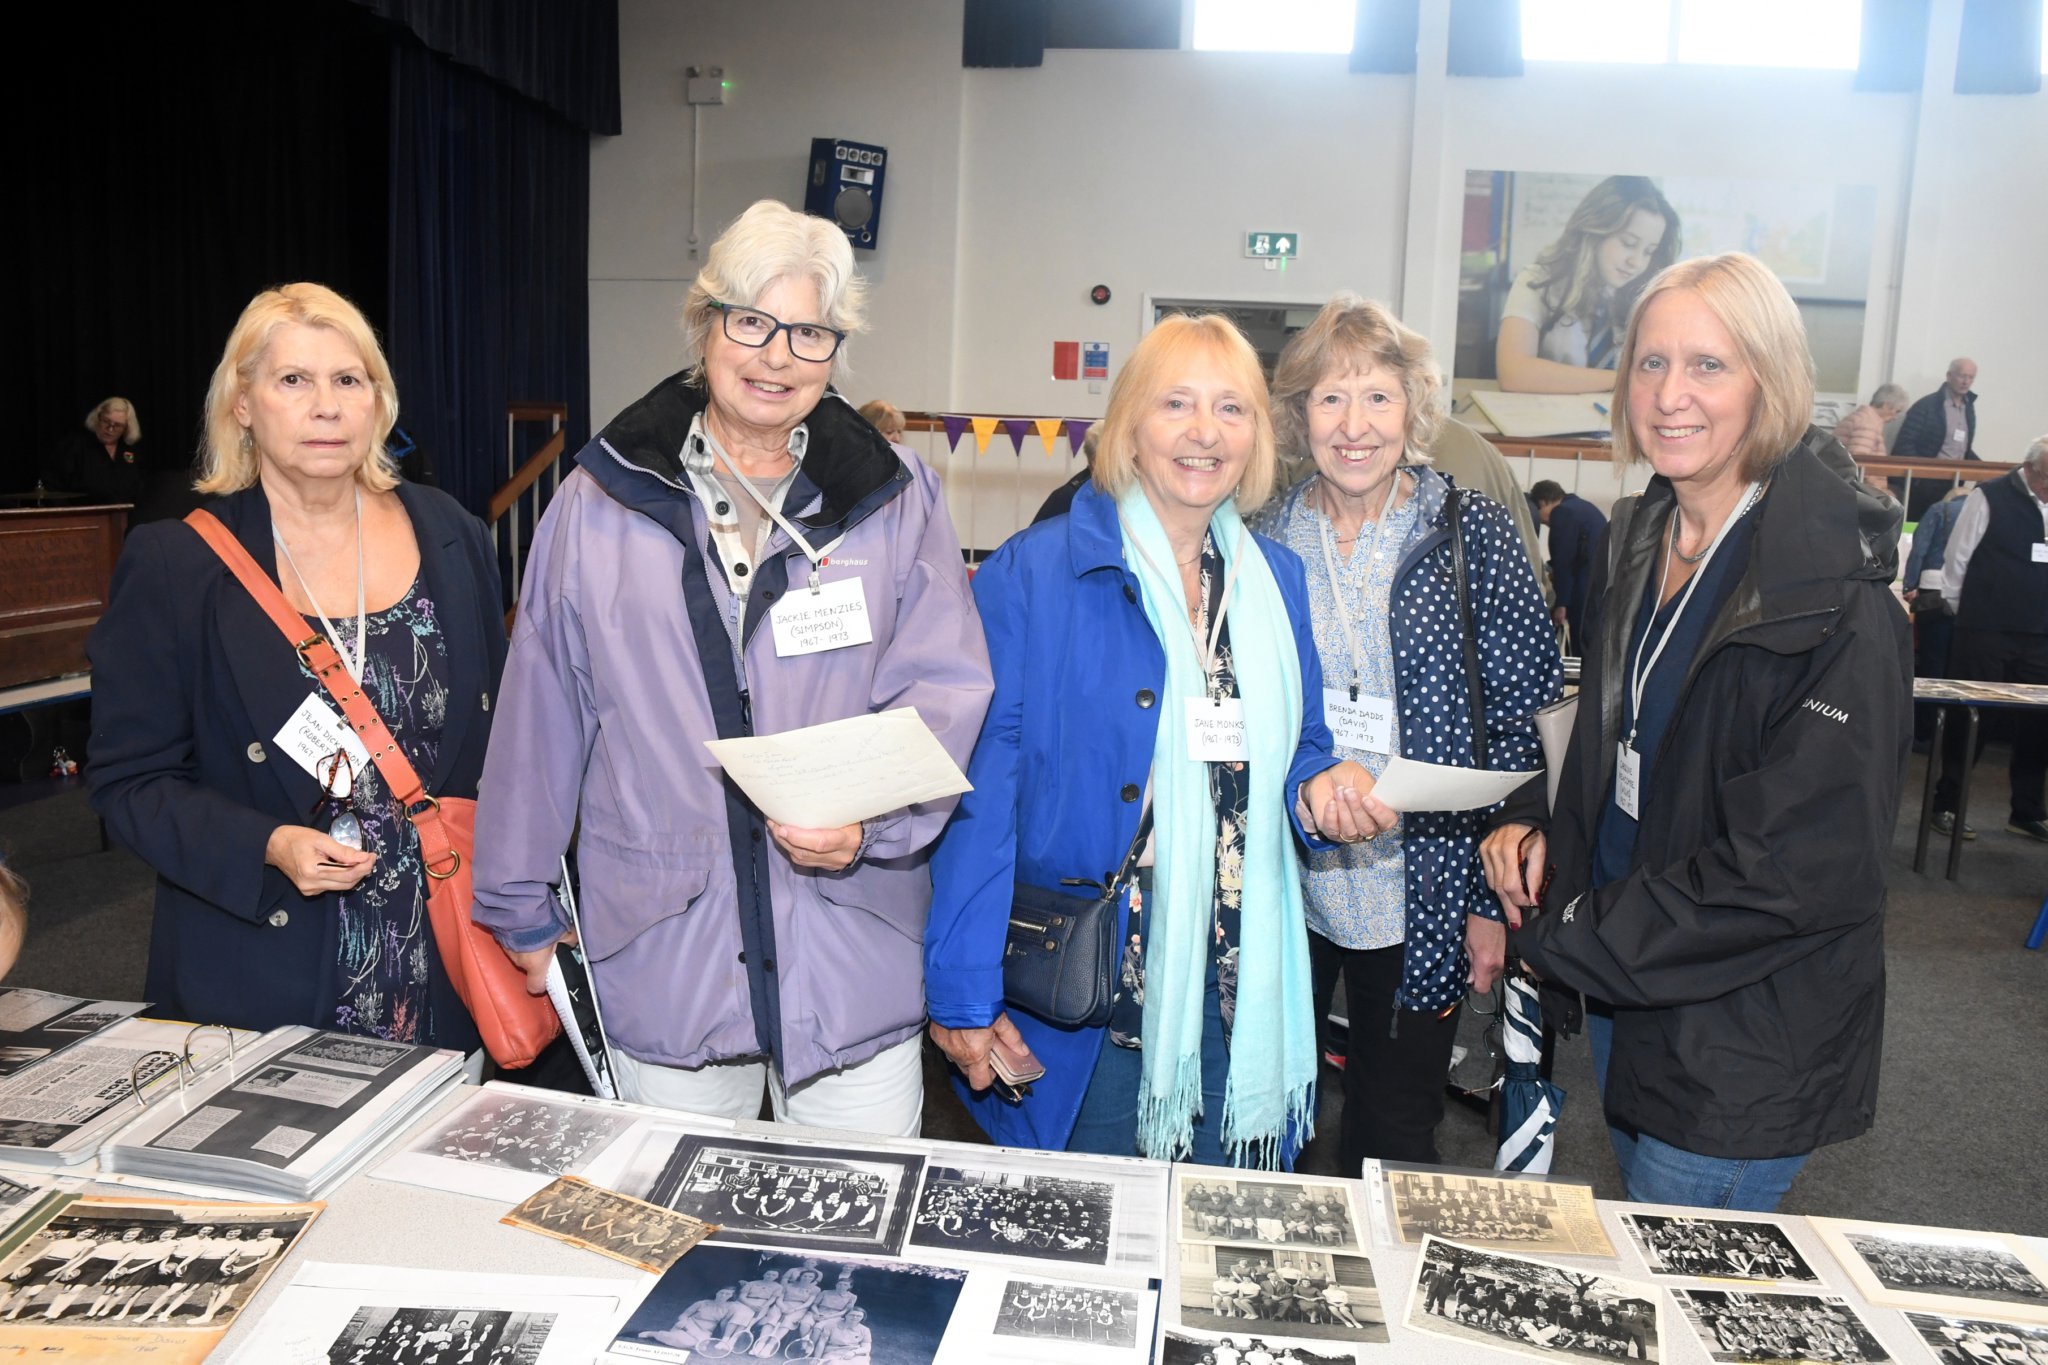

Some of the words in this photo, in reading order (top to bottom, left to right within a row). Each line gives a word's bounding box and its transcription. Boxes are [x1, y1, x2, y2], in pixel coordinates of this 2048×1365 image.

[831, 557, 868, 567] berghaus
[776, 610, 811, 625] JACKIE
[814, 601, 863, 618] MENZIES
[790, 616, 844, 639] (SIMPSON)
[301, 709, 322, 732] JEAN
[1328, 703, 1357, 715] BRENDA
[1359, 710, 1384, 721] DADDS
[1194, 718, 1215, 729] JANE
[1216, 719, 1245, 730] MONKS
